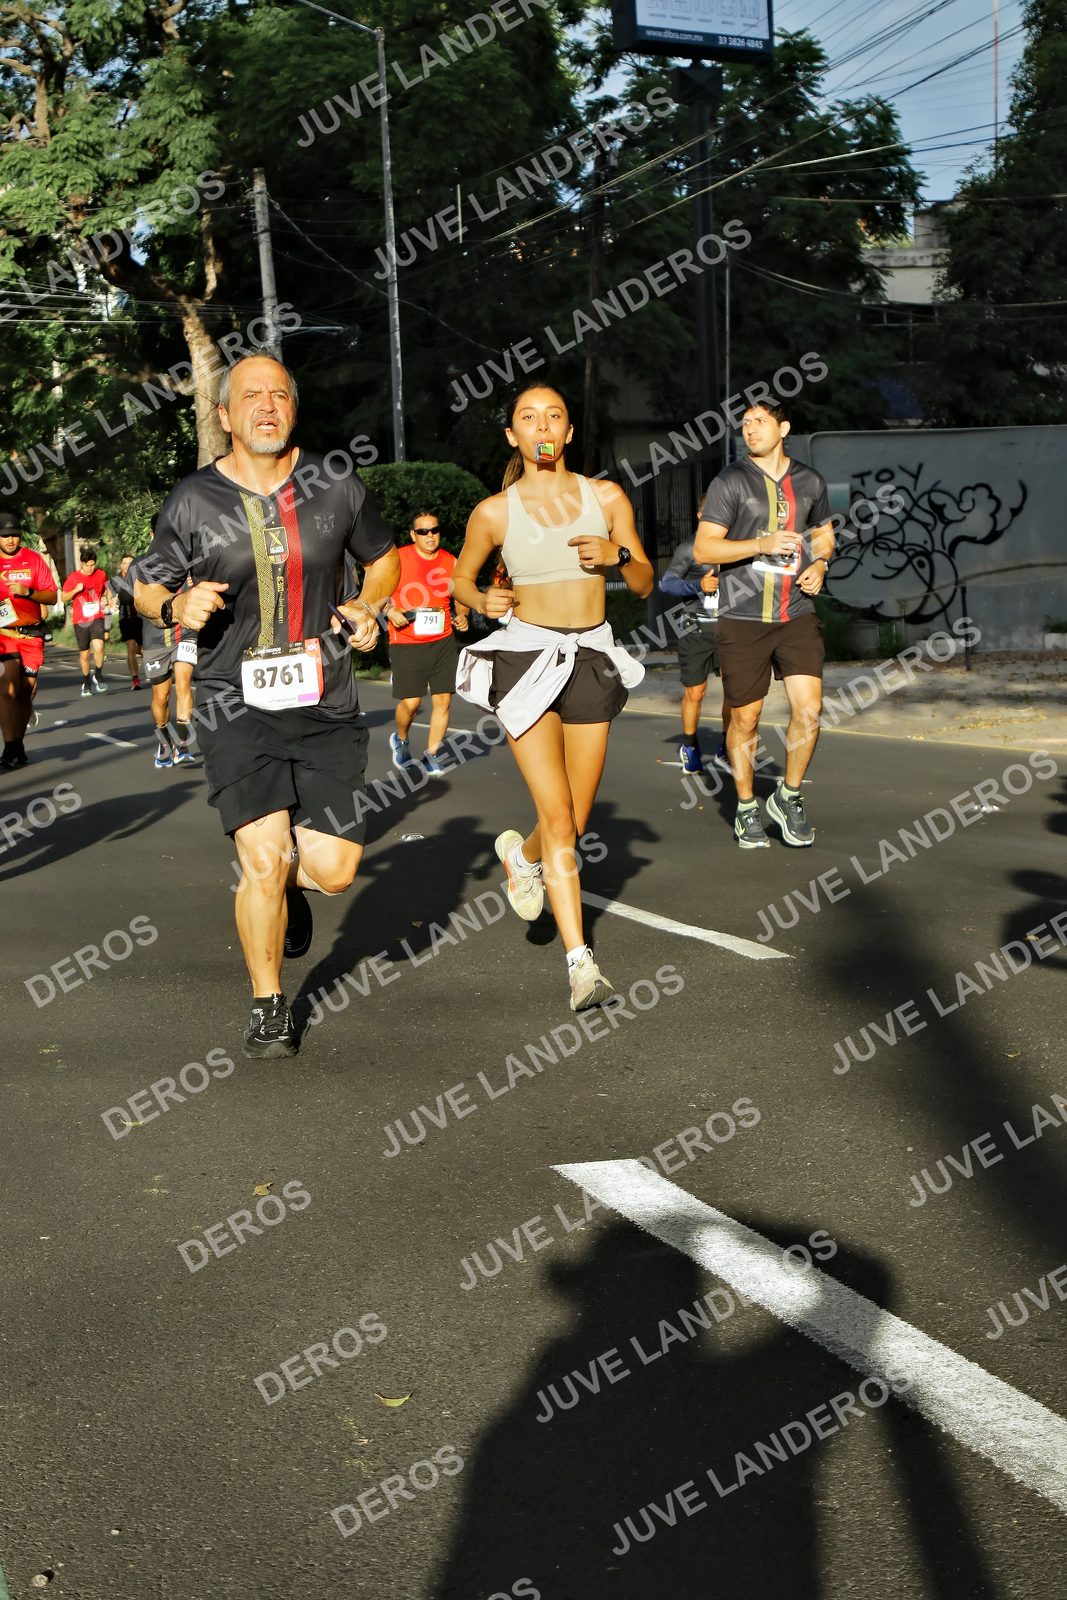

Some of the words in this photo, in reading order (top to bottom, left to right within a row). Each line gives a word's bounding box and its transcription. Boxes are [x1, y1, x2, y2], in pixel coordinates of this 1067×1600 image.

[717, 36, 727, 45] 33
[852, 462, 923, 491] TOY
[424, 615, 438, 624] 791
[253, 662, 304, 689] 8761
